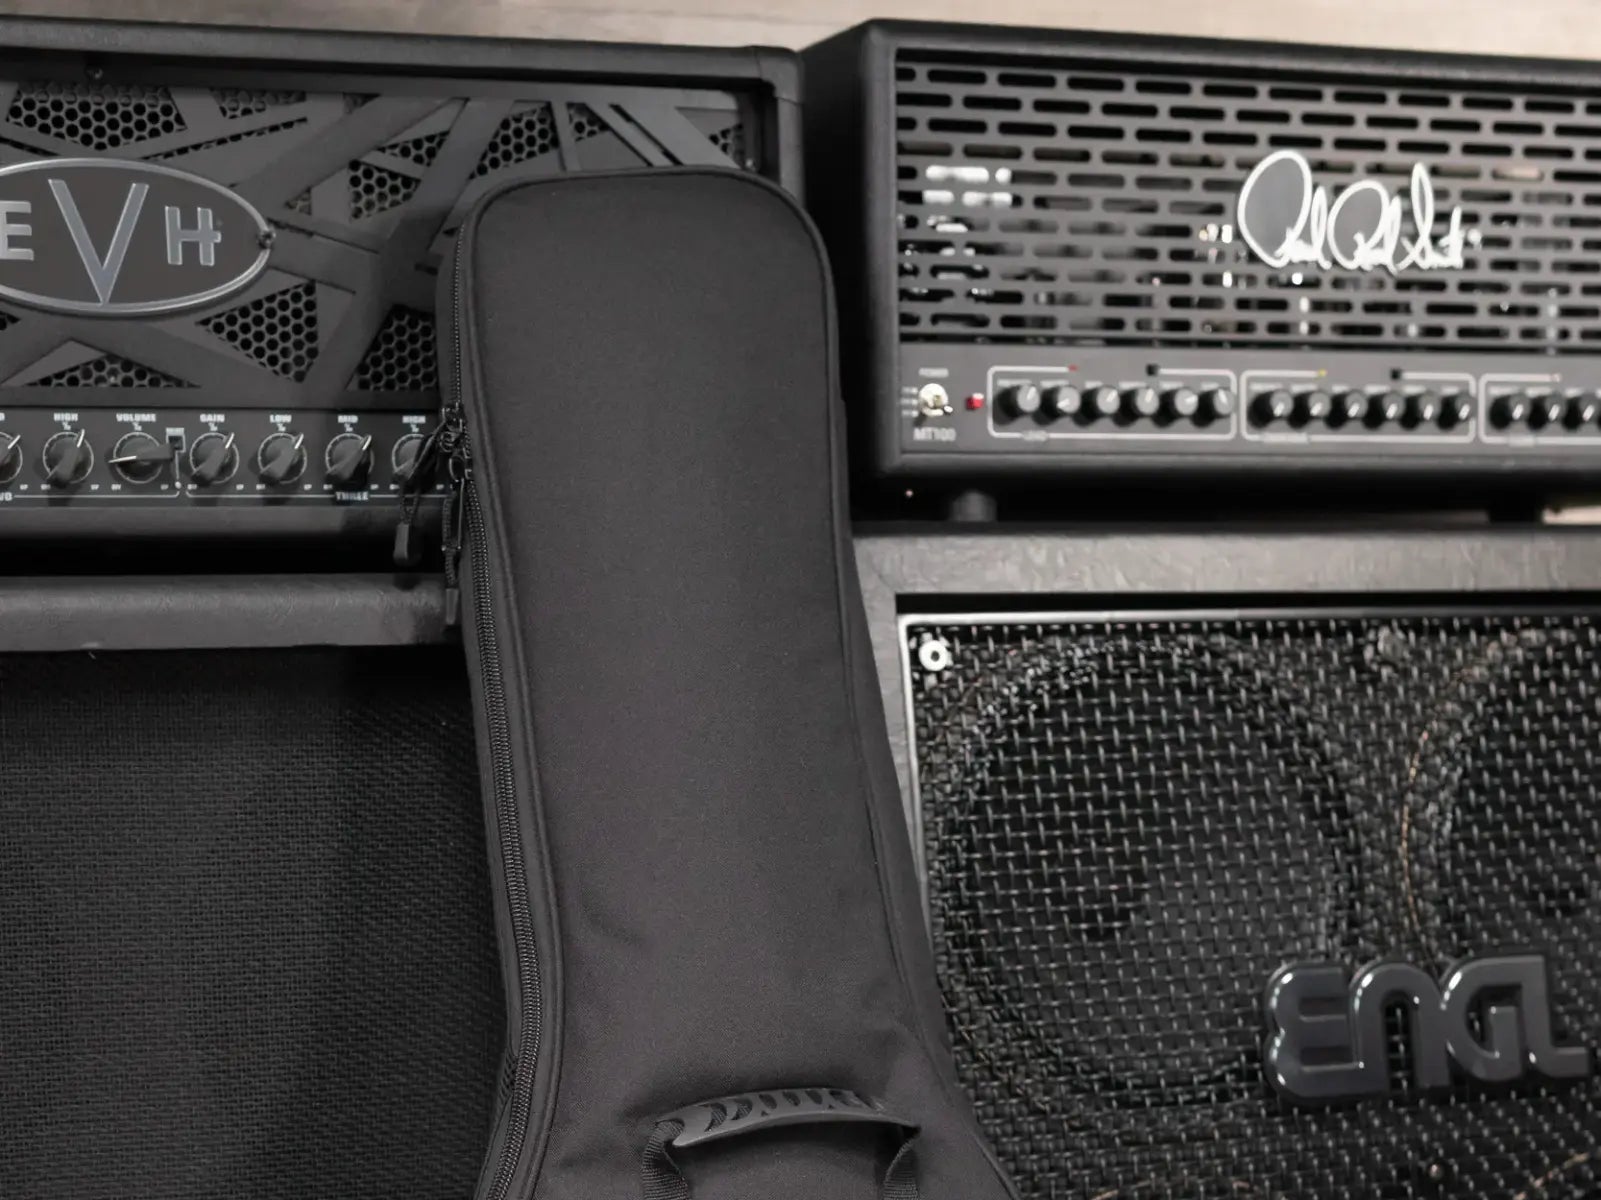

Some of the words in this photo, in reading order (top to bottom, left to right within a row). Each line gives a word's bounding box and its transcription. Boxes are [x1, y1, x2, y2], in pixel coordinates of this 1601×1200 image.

[0, 179, 222, 306] EVH
[116, 413, 157, 423] VOLUME
[200, 414, 226, 423] GAIN
